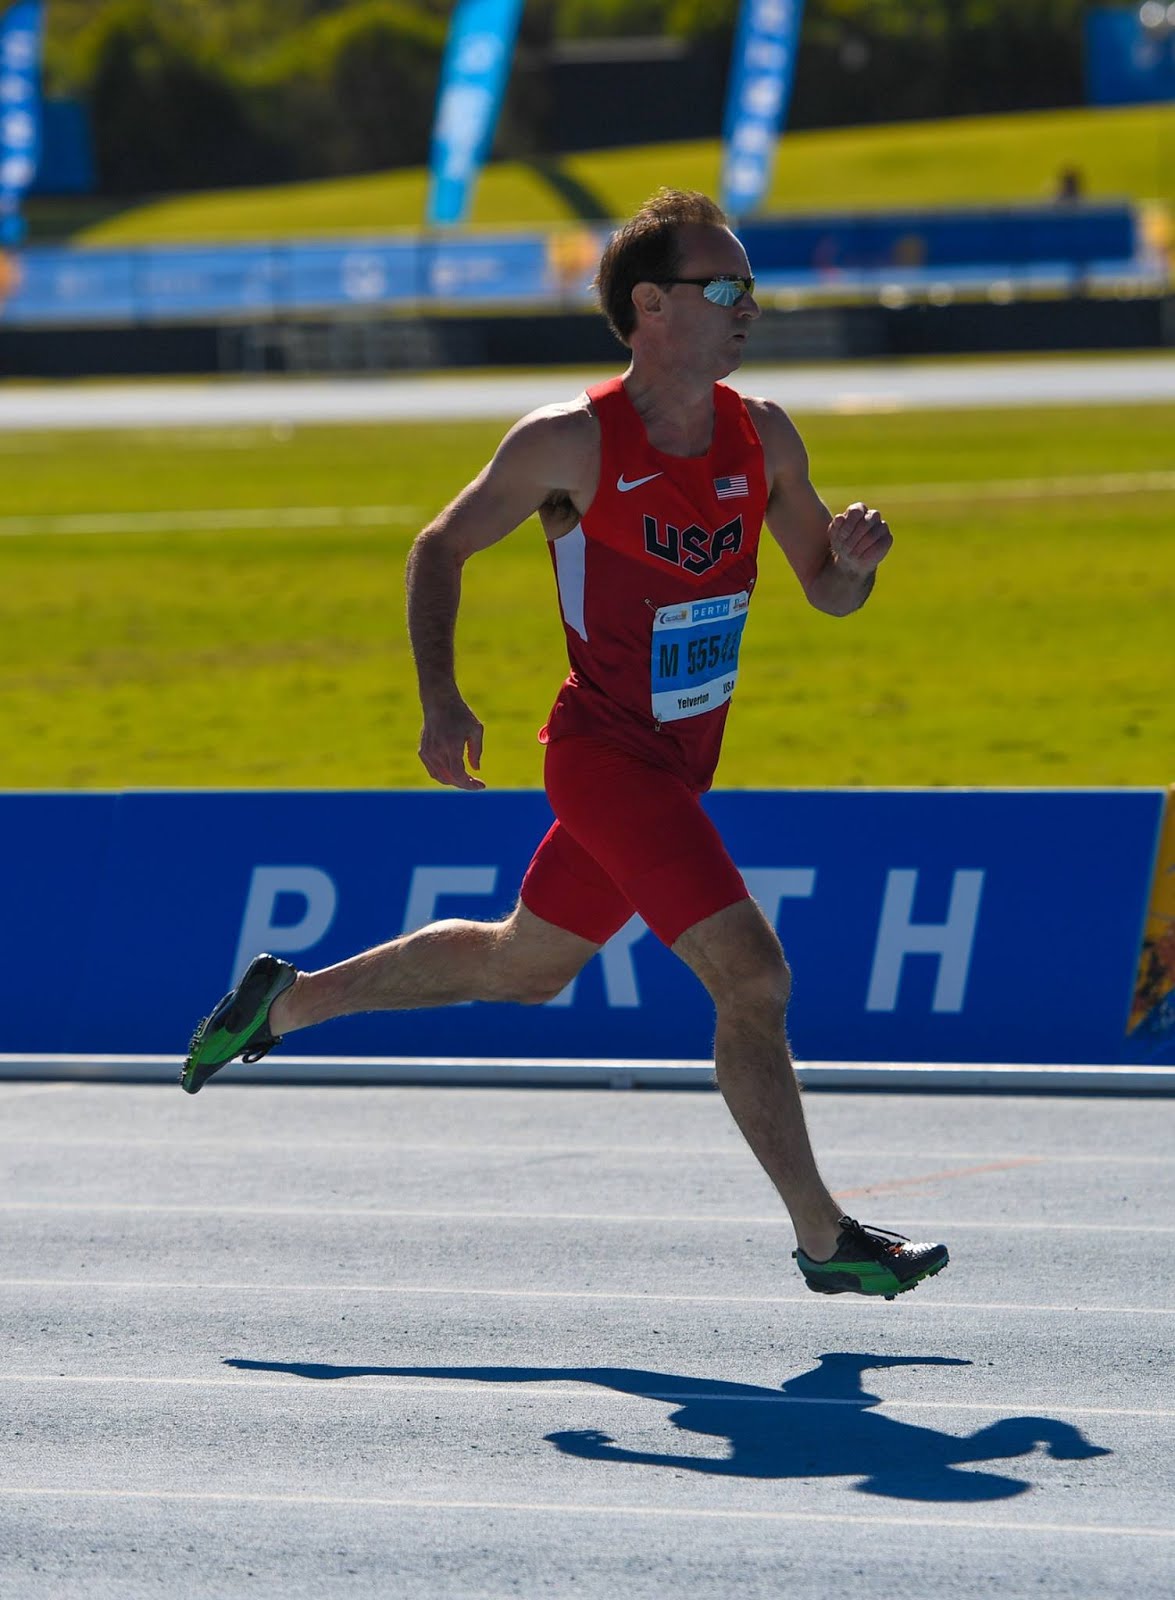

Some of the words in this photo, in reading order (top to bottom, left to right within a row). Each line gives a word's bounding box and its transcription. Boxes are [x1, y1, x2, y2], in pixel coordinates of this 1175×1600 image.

[643, 514, 743, 576] USA
[693, 603, 728, 618] PERTH
[660, 643, 679, 678] M
[677, 693, 709, 709] Yelverton
[723, 680, 734, 694] USA
